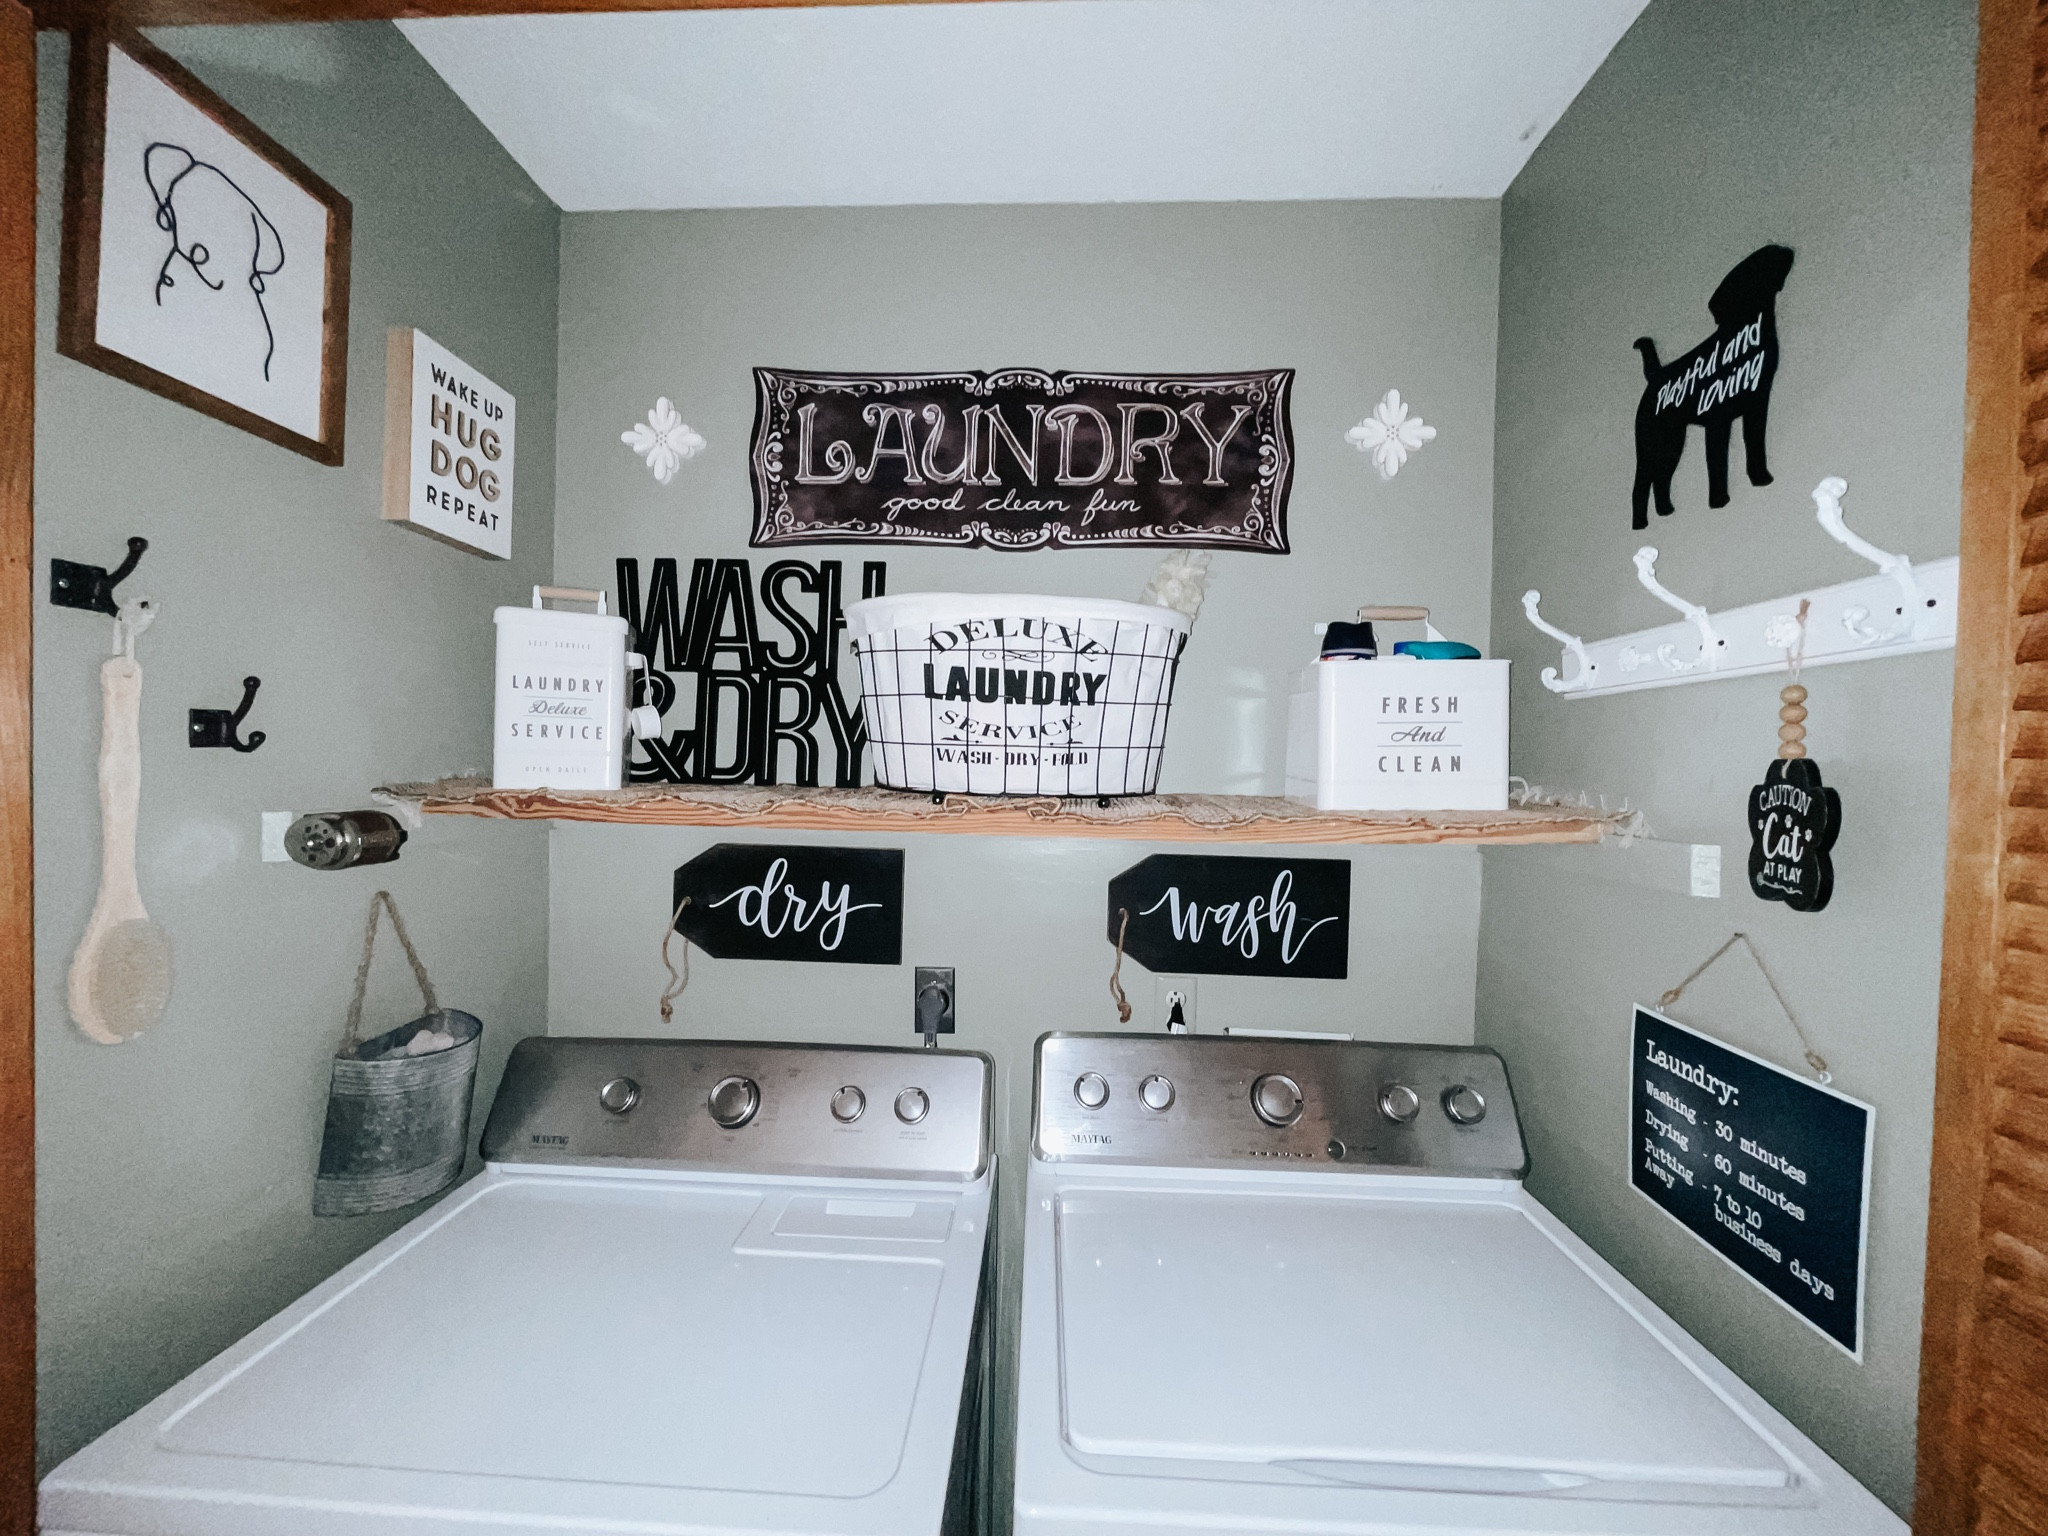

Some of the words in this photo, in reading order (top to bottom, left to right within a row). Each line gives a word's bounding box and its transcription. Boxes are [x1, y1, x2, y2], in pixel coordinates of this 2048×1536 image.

[1722, 312, 1762, 366] and
[431, 362, 478, 409] WAKE
[484, 402, 503, 421] UP
[431, 394, 502, 462] HUG
[795, 402, 1254, 486] LAUNDRY
[431, 439, 501, 502] DOG
[427, 485, 498, 531] REPEAT
[882, 491, 968, 524] good
[978, 489, 1070, 512] clean
[1081, 490, 1141, 526] fun
[616, 558, 886, 673] WASH
[923, 616, 1108, 663] DELUXE
[512, 675, 604, 693] LAUNDRY
[528, 700, 588, 715] Deluxe
[923, 663, 1107, 707] LAUNDRY
[1382, 697, 1459, 713] FRESH
[511, 723, 603, 740] SERVICE
[938, 709, 1083, 740] SERVICE
[1391, 726, 1447, 742] And
[1378, 756, 1461, 772] CLEAN
[1759, 784, 1812, 816] CAUTION
[1762, 812, 1804, 862] Cat
[1763, 861, 1776, 877] AT
[1777, 863, 1802, 884] PLAY
[709, 857, 883, 951] dry
[1140, 870, 1340, 964] wash
[1646, 1039, 1739, 1107] Laundry:
[1071, 1134, 1112, 1145] MAYTAG
[1646, 1079, 1696, 1125] Washing
[1715, 1120, 1733, 1142] 30
[1739, 1137, 1807, 1185] minutes
[1645, 1109, 1689, 1152] Drying
[1714, 1153, 1732, 1175] 60
[1739, 1171, 1806, 1222] minutes
[1645, 1157, 1675, 1189] Away
[1645, 1137, 1694, 1186] Putting
[1714, 1184, 1722, 1201] 7
[1726, 1194, 1741, 1216] to
[1745, 1205, 1762, 1230] 10
[1714, 1203, 1782, 1264] business
[1790, 1258, 1835, 1301] days
